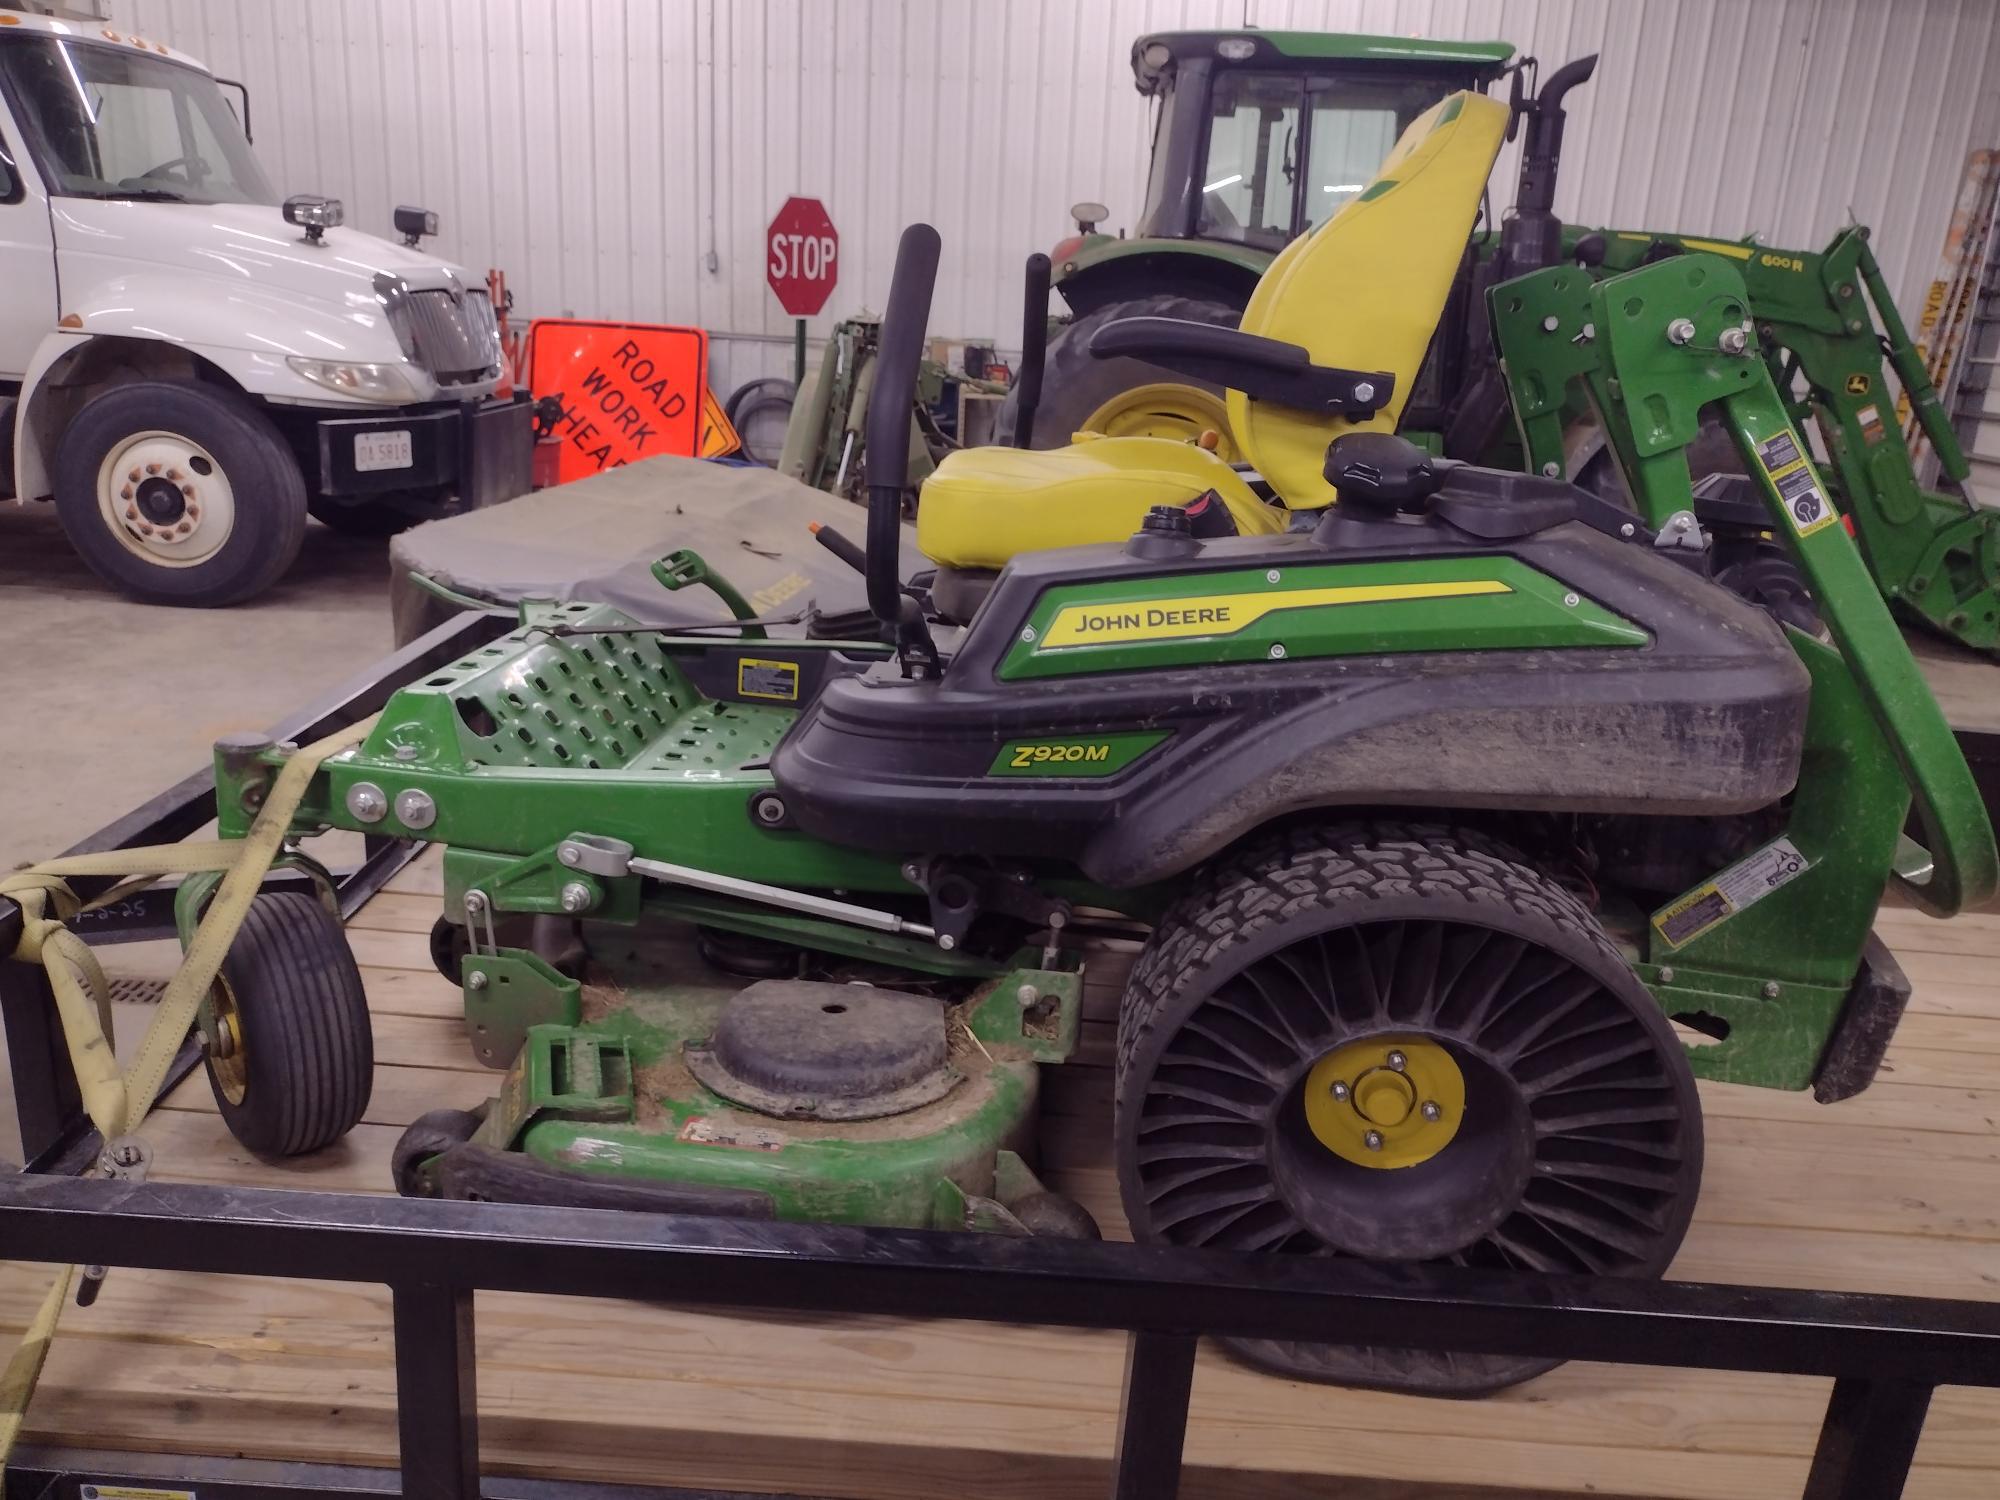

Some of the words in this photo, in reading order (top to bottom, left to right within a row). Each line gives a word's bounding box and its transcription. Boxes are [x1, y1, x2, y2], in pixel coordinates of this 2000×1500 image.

[770, 233, 836, 281] STOP
[1921, 278, 1948, 328] ROAD
[612, 339, 686, 419] ROAD
[553, 392, 628, 470] HEA
[582, 366, 657, 450] WORK
[1074, 614, 1140, 633] JOHN
[1147, 607, 1231, 627] DEERE
[1010, 745, 1110, 767] Z920M
